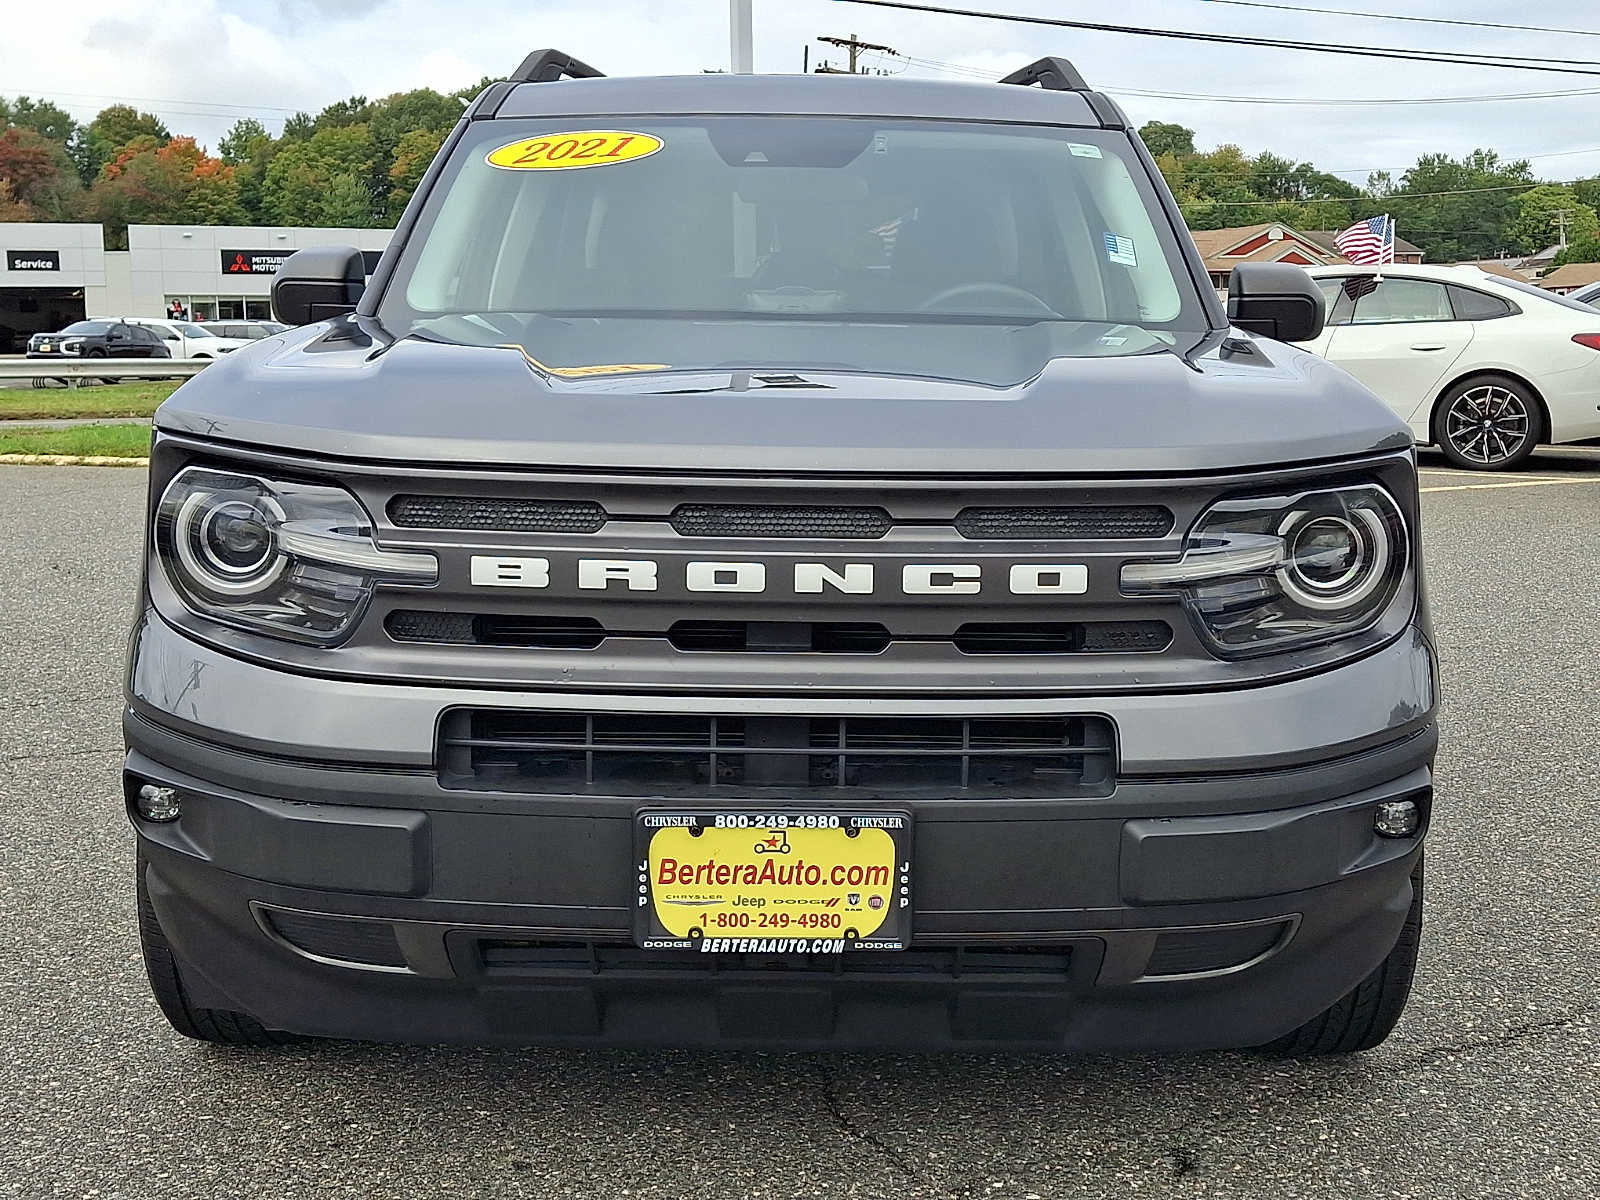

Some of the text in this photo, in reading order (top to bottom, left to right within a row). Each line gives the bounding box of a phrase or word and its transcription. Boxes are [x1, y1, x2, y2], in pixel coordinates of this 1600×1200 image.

[512, 136, 635, 164] 2021
[14, 259, 53, 269] Service
[251, 256, 285, 264] MITSUBI
[470, 556, 1089, 595] BRONCO
[644, 816, 697, 827] CHRYSLER
[714, 815, 840, 829] 800-249-4980
[850, 817, 904, 828] CHRYSLER
[658, 858, 889, 886] BerteraAuto.com
[638, 860, 648, 908] Jeep
[899, 862, 910, 909] Jeep
[732, 895, 767, 909] Jeep
[699, 913, 842, 929] 1-800-249-4980
[701, 938, 846, 953] BERTERAAUTO.COM
